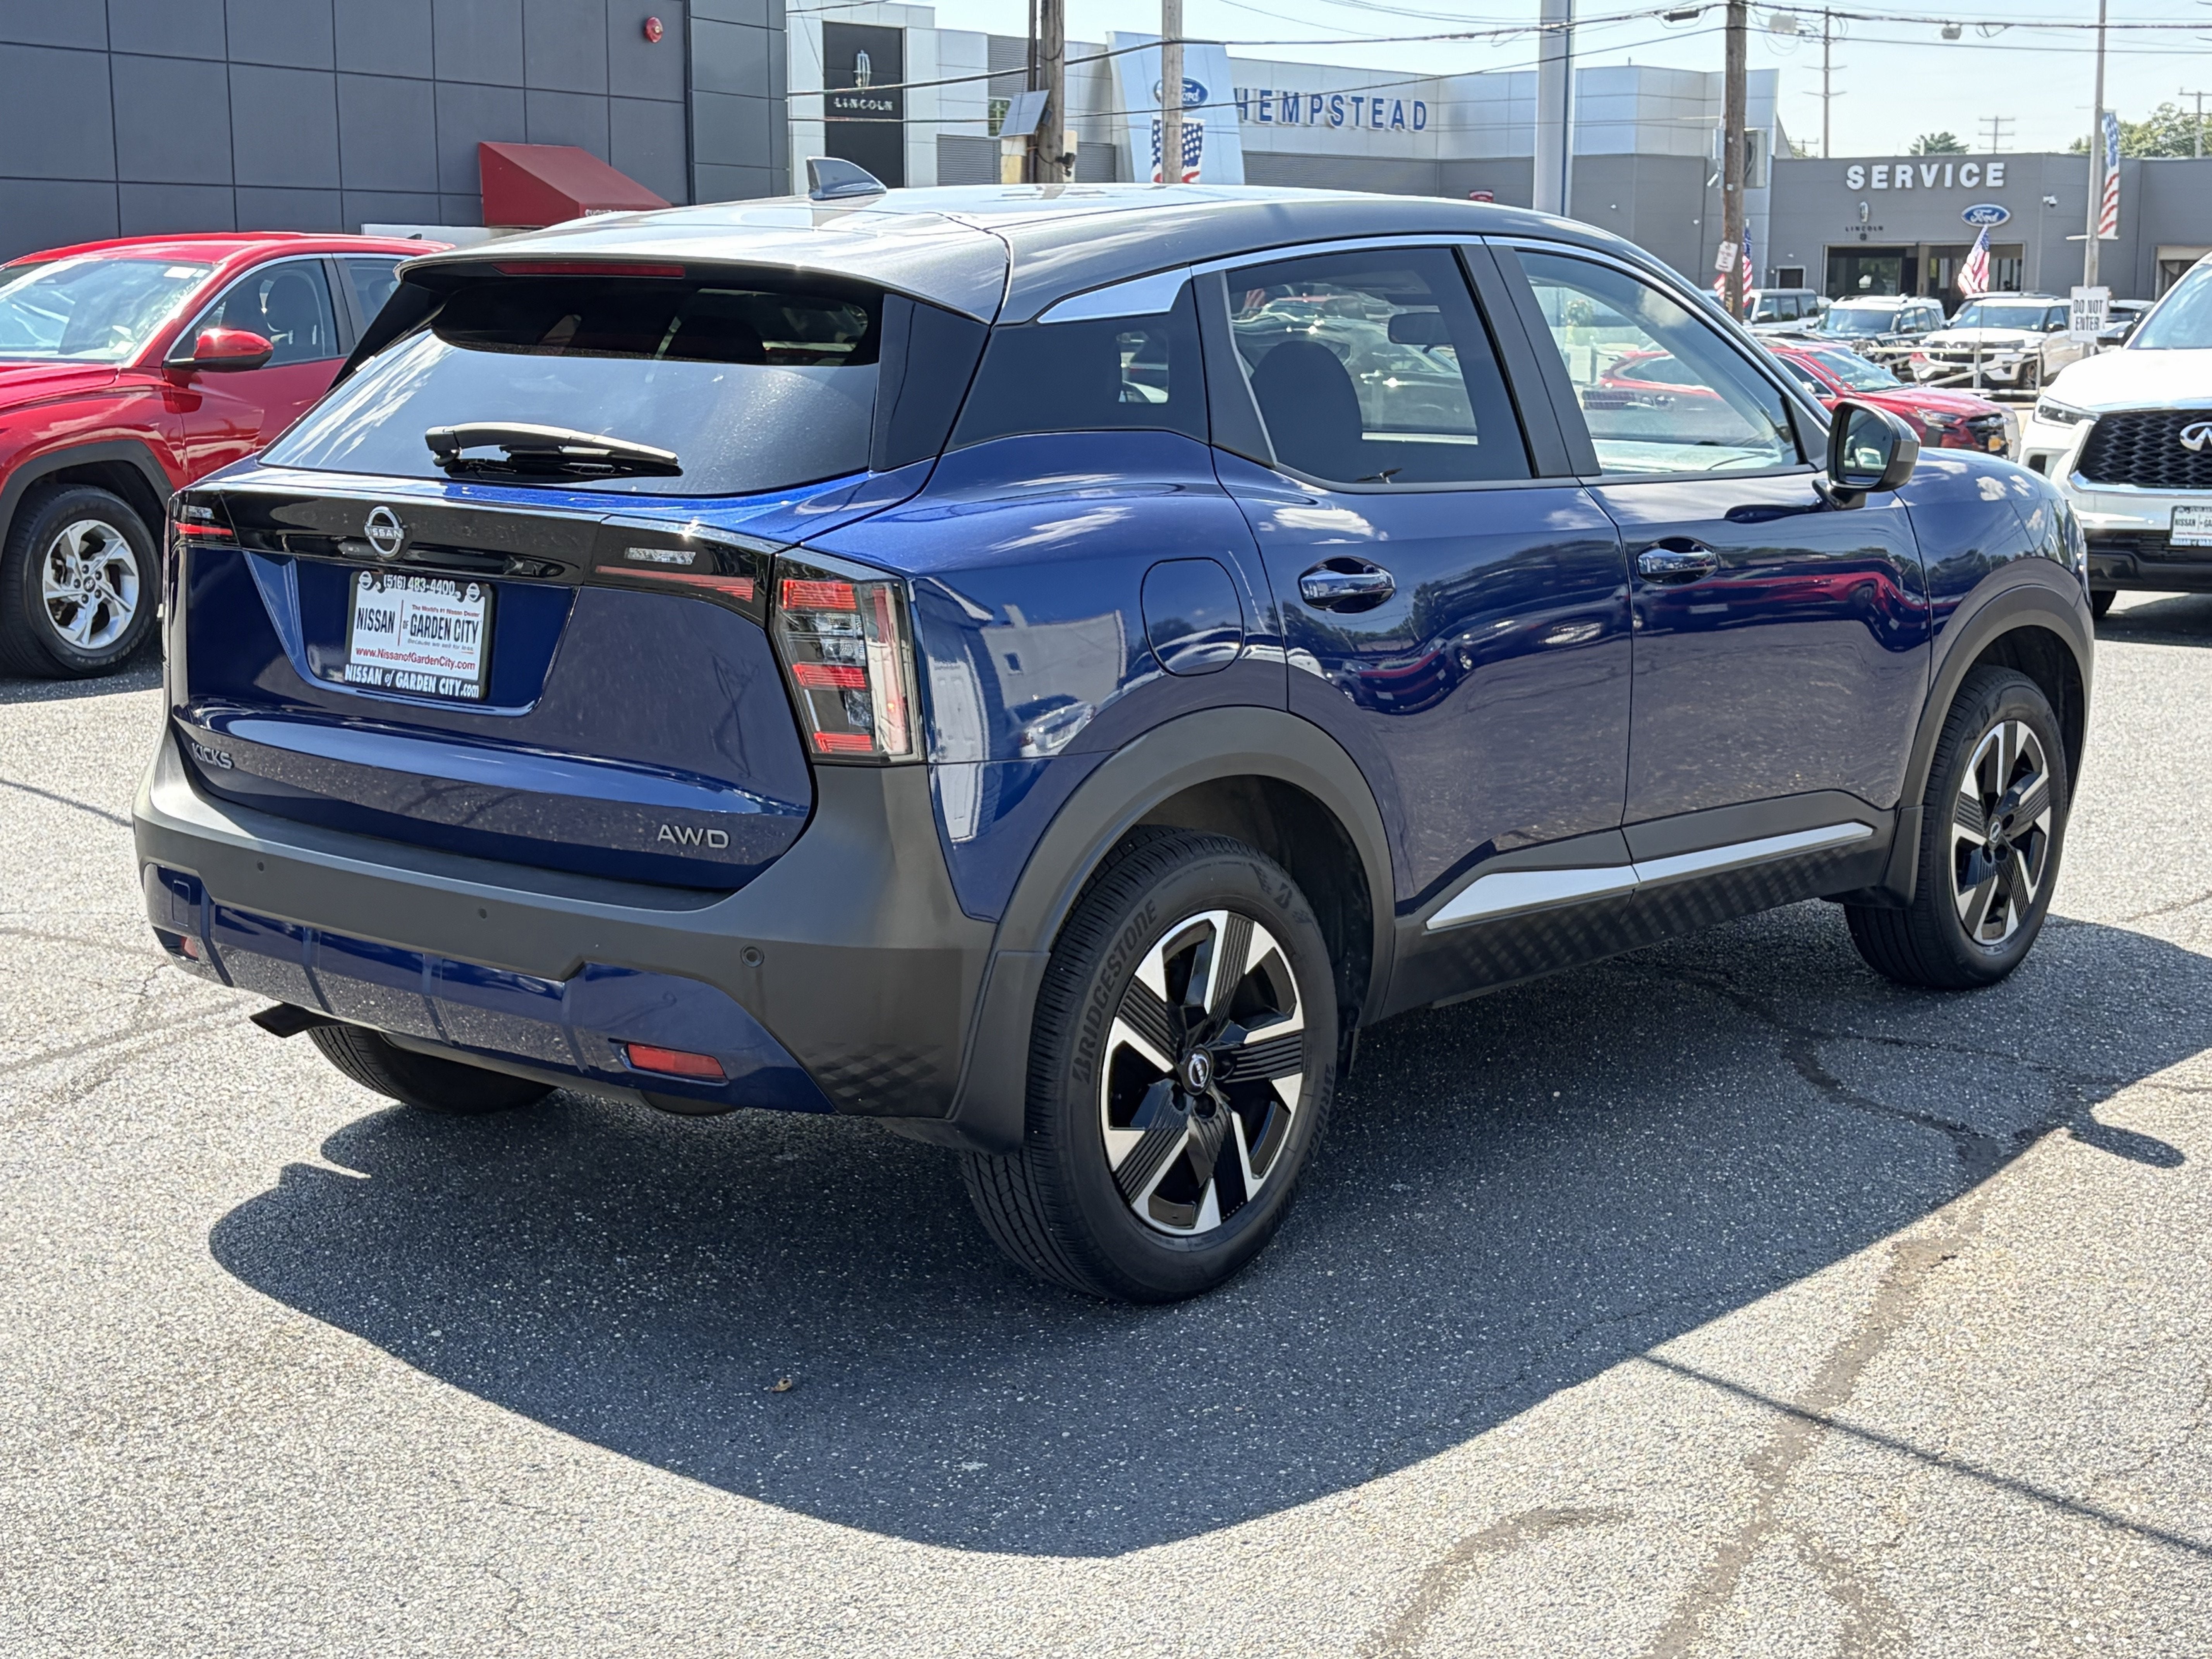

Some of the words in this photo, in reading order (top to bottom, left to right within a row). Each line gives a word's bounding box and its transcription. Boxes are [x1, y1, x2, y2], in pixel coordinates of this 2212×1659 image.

[834, 98, 893, 111] LINCOLN
[1233, 87, 1427, 131] HEMPSTEAD
[1846, 162, 2005, 190] SERVICE
[1970, 209, 1999, 223] Ford
[2073, 299, 2085, 314] DO
[2087, 299, 2104, 314] NOT
[2075, 316, 2100, 331] ENTER
[384, 574, 406, 590] (516)
[408, 577, 455, 595] 483-4400
[356, 607, 395, 634] NISSAN
[410, 613, 452, 641] GARDEN
[454, 618, 479, 644] CITY
[356, 647, 476, 670] www.NissanofGardenCity.com
[345, 664, 383, 685] NISSAN
[395, 672, 436, 693] GARDEN
[192, 742, 232, 769] KICKS
[657, 824, 729, 848] AWD
[1072, 898, 1158, 1085] BRIDGESTONE
